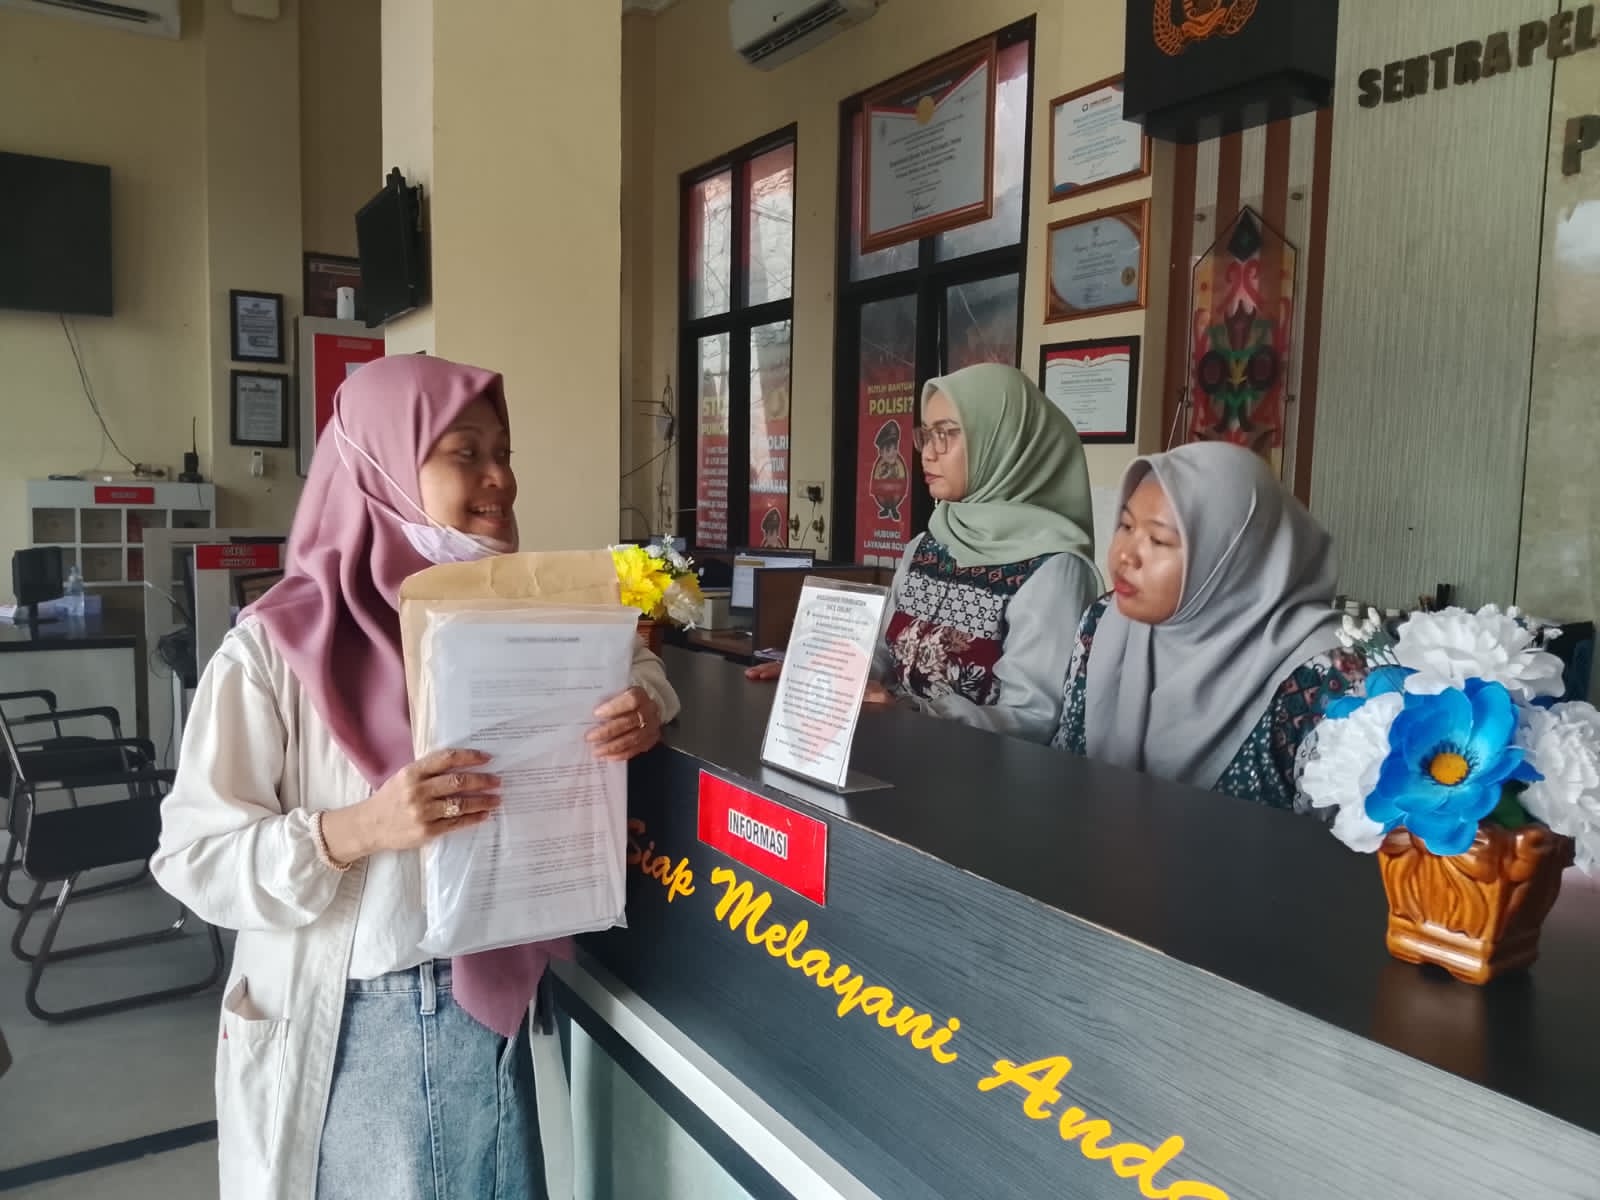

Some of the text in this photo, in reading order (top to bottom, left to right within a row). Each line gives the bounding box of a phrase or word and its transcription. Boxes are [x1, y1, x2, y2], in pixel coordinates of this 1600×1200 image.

[1358, 5, 1600, 109] SENTRA PEL
[869, 397, 914, 416] POLISI?
[764, 435, 789, 451] OLRI
[729, 811, 788, 858] INFORMASI
[627, 817, 696, 903] Siap
[711, 866, 960, 1064] Melayani
